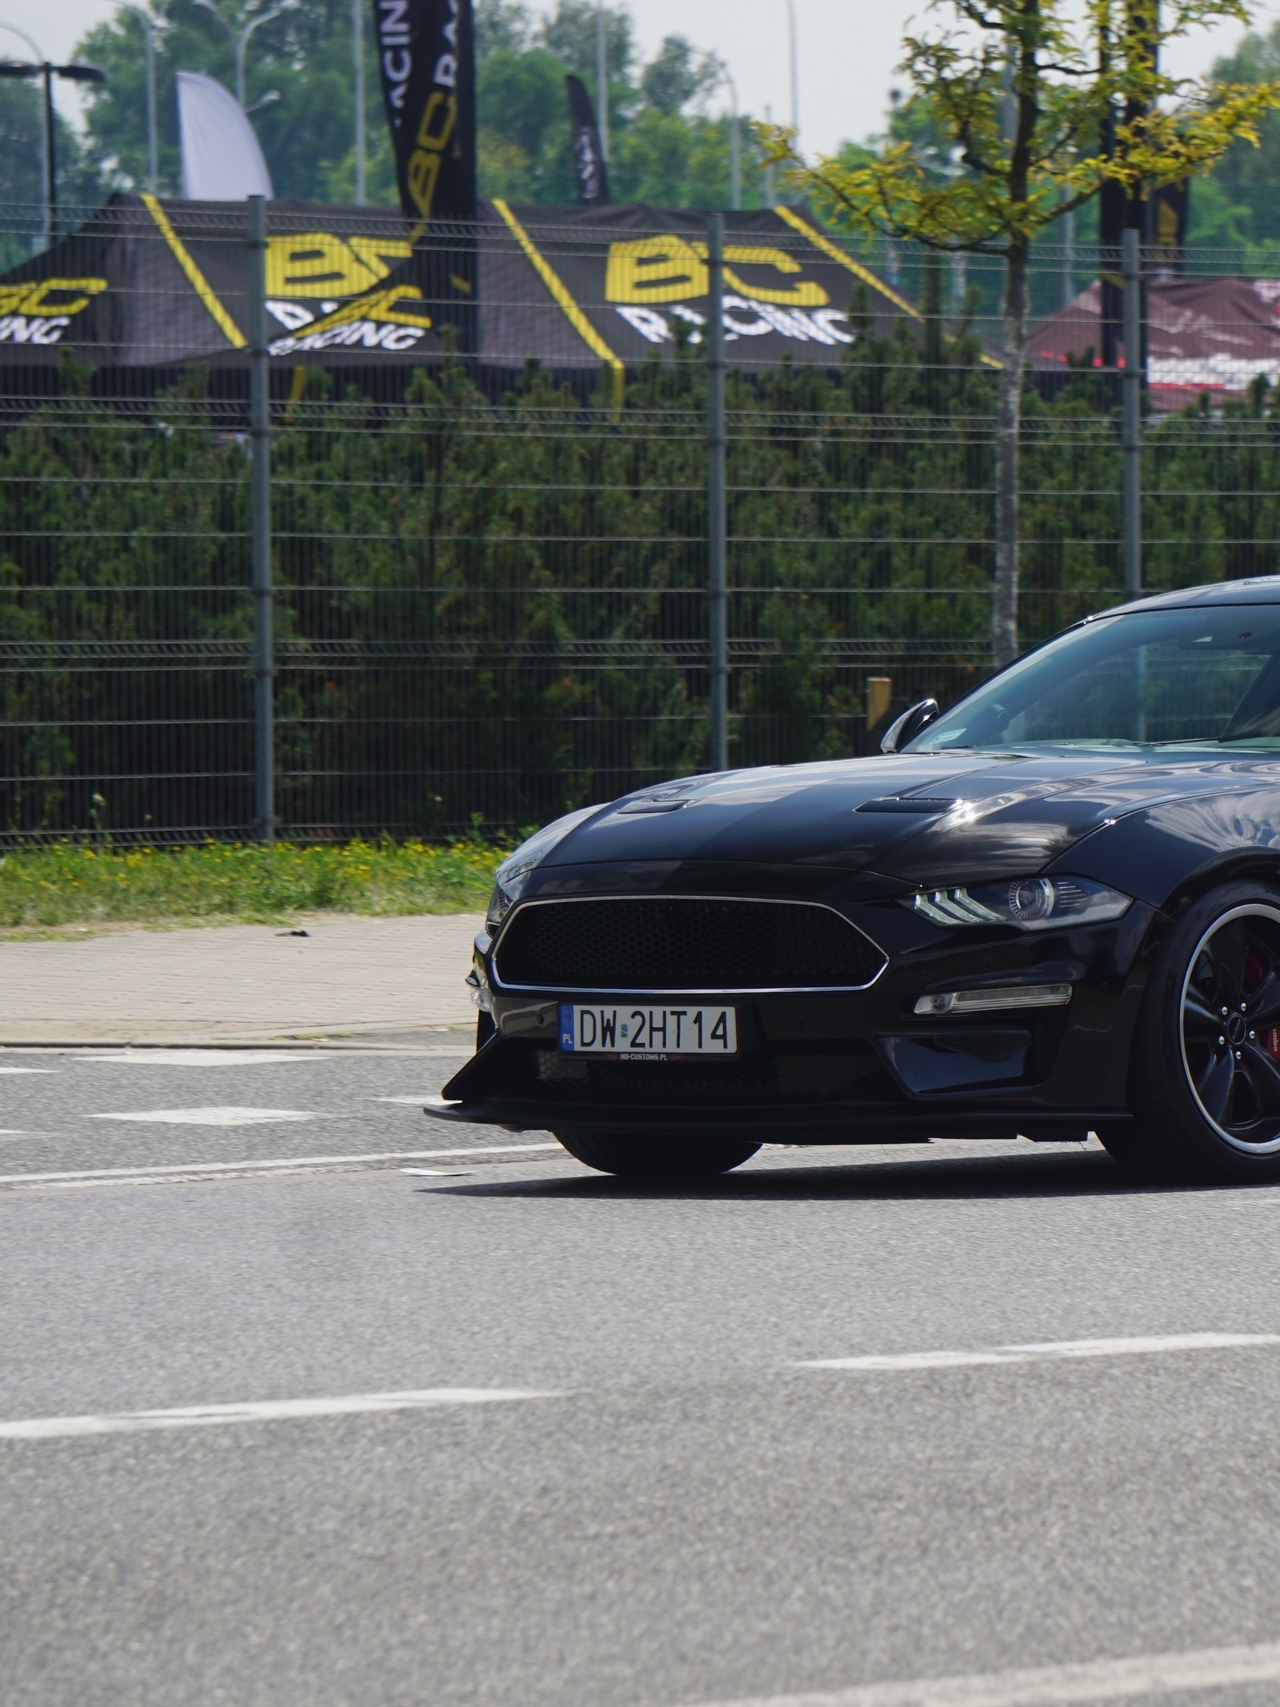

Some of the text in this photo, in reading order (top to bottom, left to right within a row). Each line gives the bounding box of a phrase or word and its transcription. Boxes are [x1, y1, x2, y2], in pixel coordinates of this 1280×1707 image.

[604, 234, 831, 306] BC
[266, 320, 426, 356] RACING
[562, 1033, 573, 1044] PL
[580, 1010, 728, 1049] DW 2HT14
[620, 1053, 668, 1061] HD-CUSTOMS.PL
